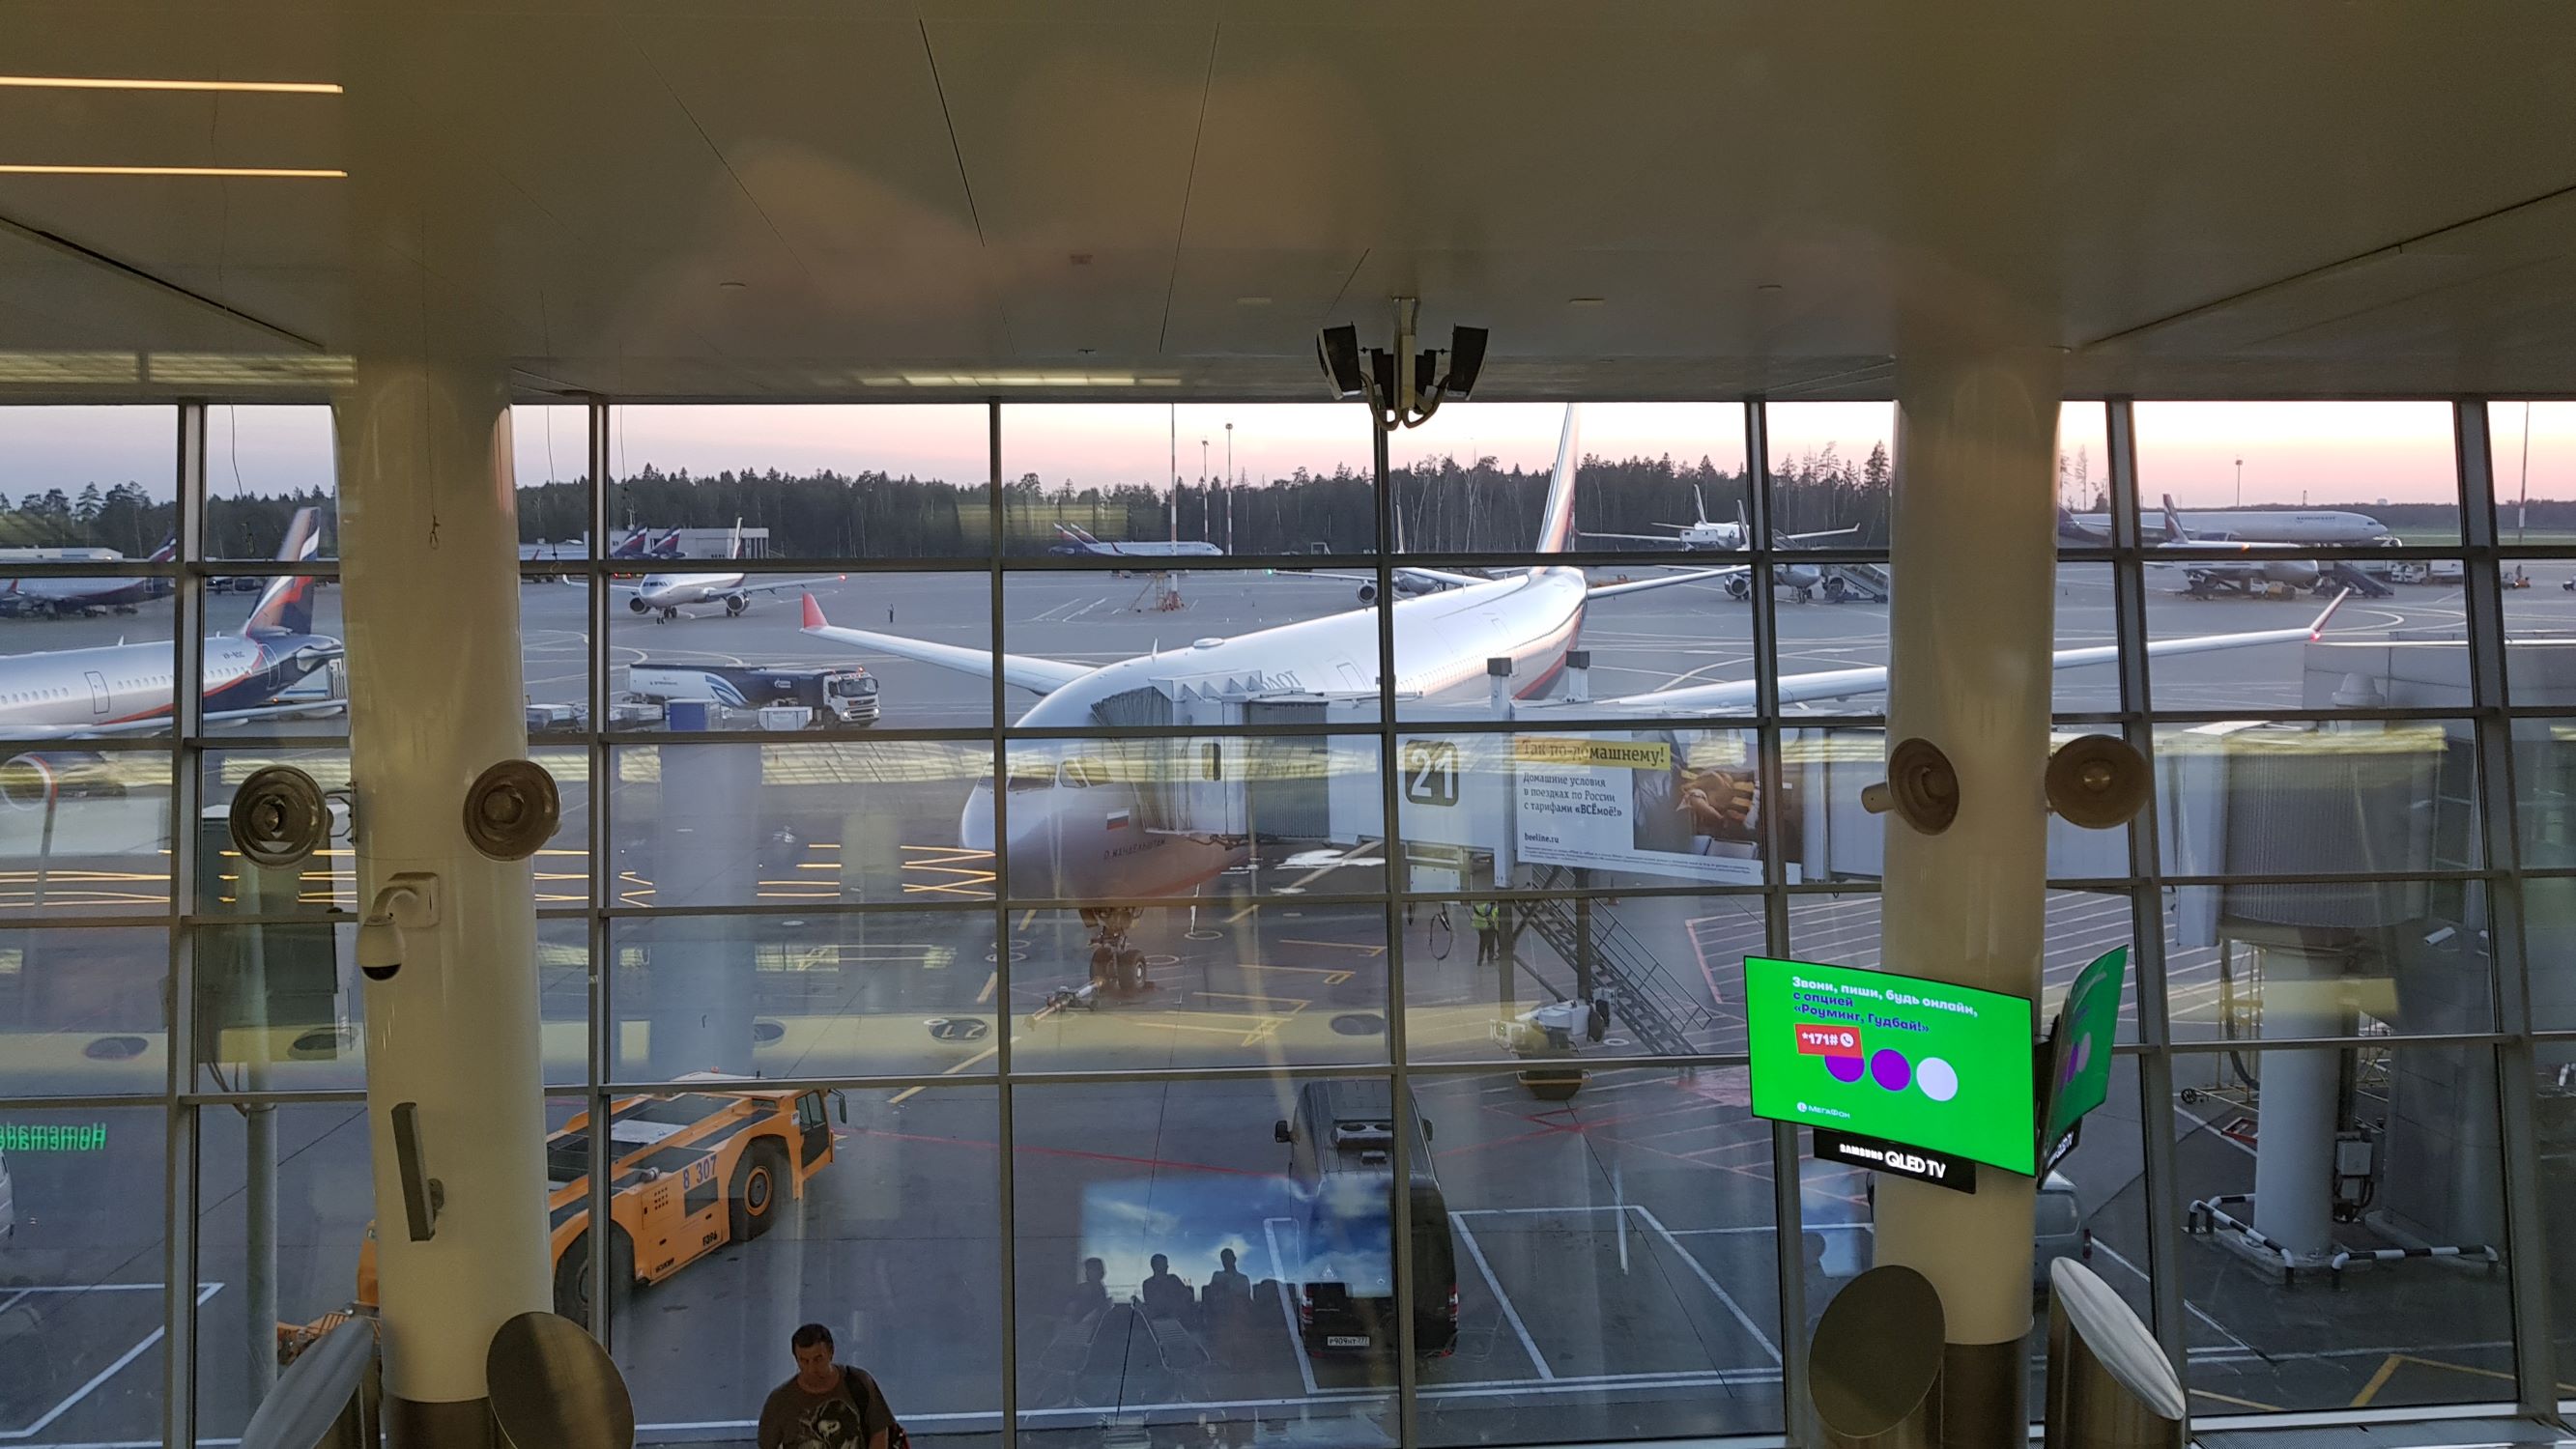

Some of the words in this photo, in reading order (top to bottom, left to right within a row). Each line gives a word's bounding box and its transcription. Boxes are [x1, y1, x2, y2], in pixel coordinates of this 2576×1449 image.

[1522, 740, 1546, 756] Так
[1550, 744, 1665, 767] по-домашнему!
[1411, 749, 1453, 800] 21
[1523, 773, 1568, 784] Домашние
[1570, 776, 1606, 787] условия
[1524, 787, 1529, 796] в
[1531, 787, 1570, 800] поездках
[1571, 791, 1583, 800] по
[1585, 789, 1616, 803] России
[1531, 802, 1573, 814] тарифами
[1524, 832, 1560, 843] beeline.ru
[1792, 976, 1838, 994] Звони,
[1841, 983, 1883, 1001] пиши,
[1885, 990, 1920, 1006] будь
[1922, 997, 1978, 1017] онлайн,
[1793, 992, 1801, 1001] с
[1804, 993, 1854, 1008] опцией
[1794, 1004, 1865, 1024] «Роуминг,
[1868, 1013, 1930, 1033] Гудбай!»
[683, 1168, 690, 1190] 8
[697, 1154, 716, 1183] 307
[1839, 1143, 1883, 1161] SAMSUNG
[1885, 1151, 1926, 1174] QLED
[1927, 1159, 1947, 1179] TV
